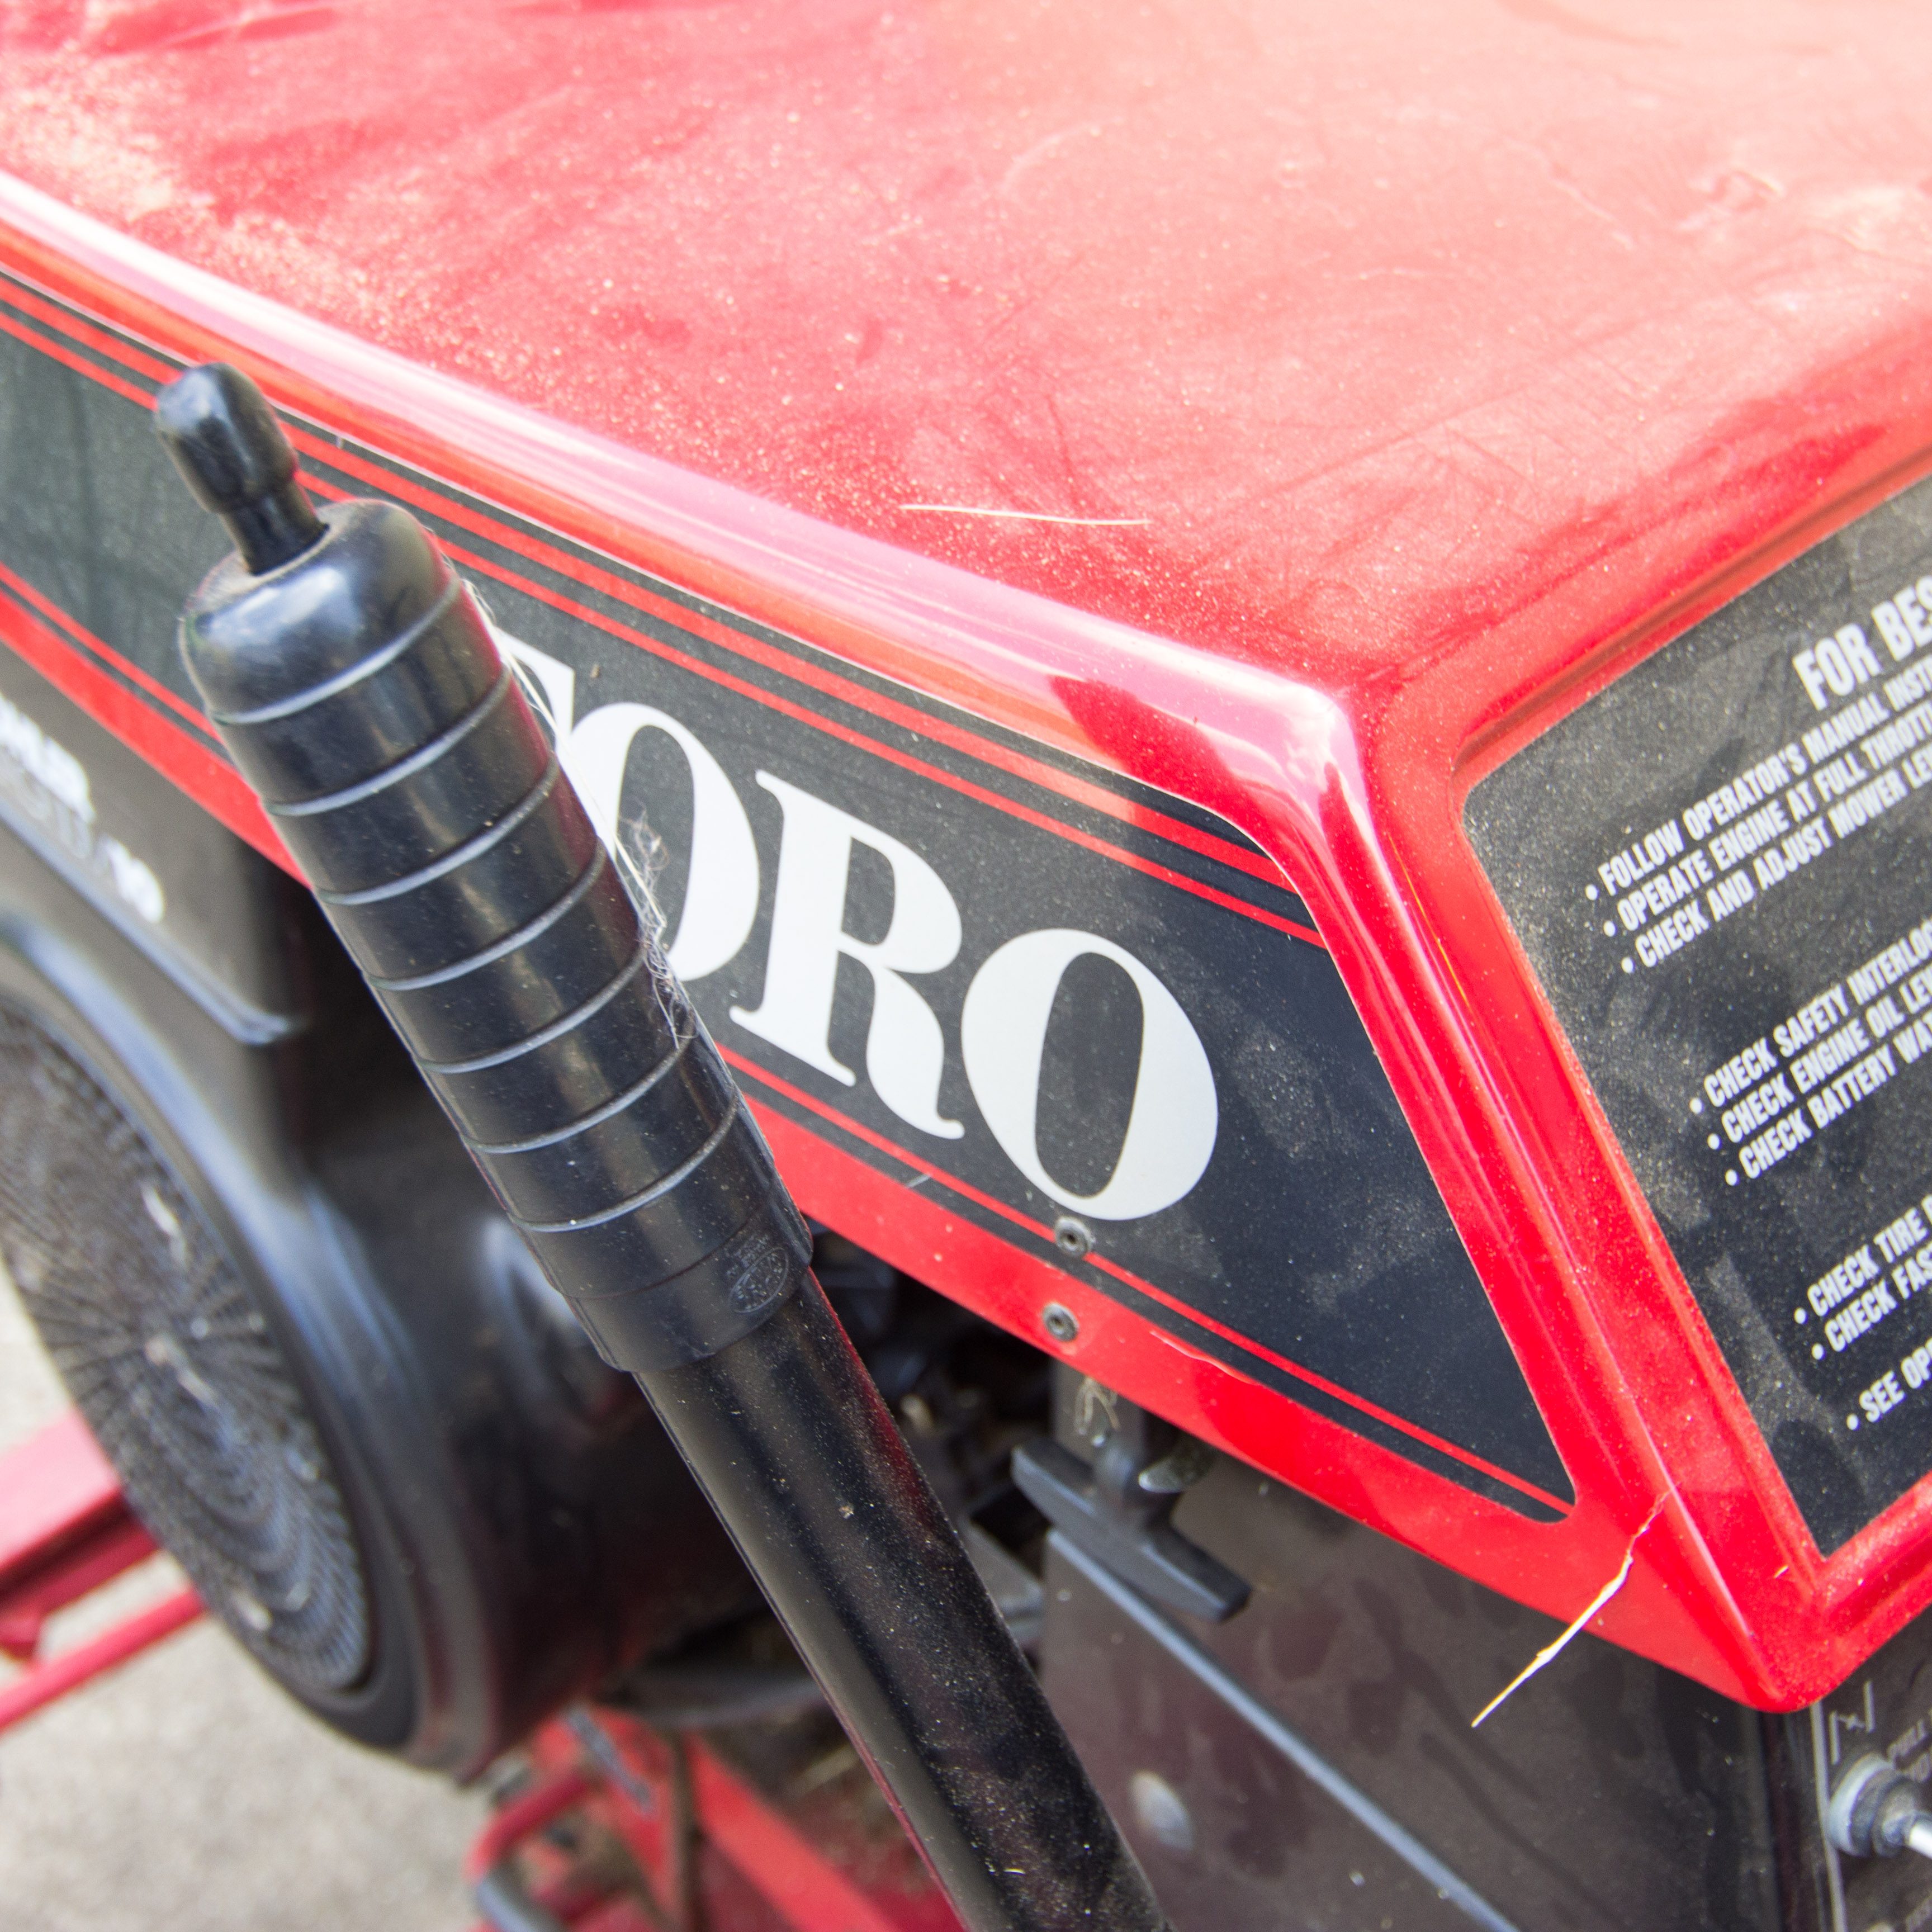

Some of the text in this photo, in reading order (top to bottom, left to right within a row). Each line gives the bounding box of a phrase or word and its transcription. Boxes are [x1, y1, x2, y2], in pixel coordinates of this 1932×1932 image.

[1793, 574, 1932, 711] FOR BE
[1598, 819, 1684, 896] FOLLOW
[1683, 742, 1807, 841] OPERATOR'S
[1801, 691, 1890, 764] MANUAL
[1617, 699, 1932, 931] OPERATE ENGINE AT FULL THROTT
[491, 625, 1219, 1221] ORO
[1635, 899, 1710, 968] CHECK
[1706, 869, 1756, 922] AND
[1753, 816, 1832, 891] ADJUST
[1827, 767, 1909, 839] MOWER
[1704, 1038, 1778, 1108] CHECK
[1773, 983, 1850, 1057] SAFETY
[1722, 1072, 1795, 1143] CHECK
[1789, 1019, 1871, 1094] ENGINE
[1865, 996, 1906, 1039] OIL
[1739, 1108, 1813, 1179] CHECK
[1807, 1044, 1897, 1129] BATTERY
[1807, 1244, 1881, 1317] CHECK
[1874, 1208, 1929, 1263] TIRE
[1825, 1241, 1932, 1352] CHECK FAS
[1859, 1337, 1932, 1423] SEE OP
